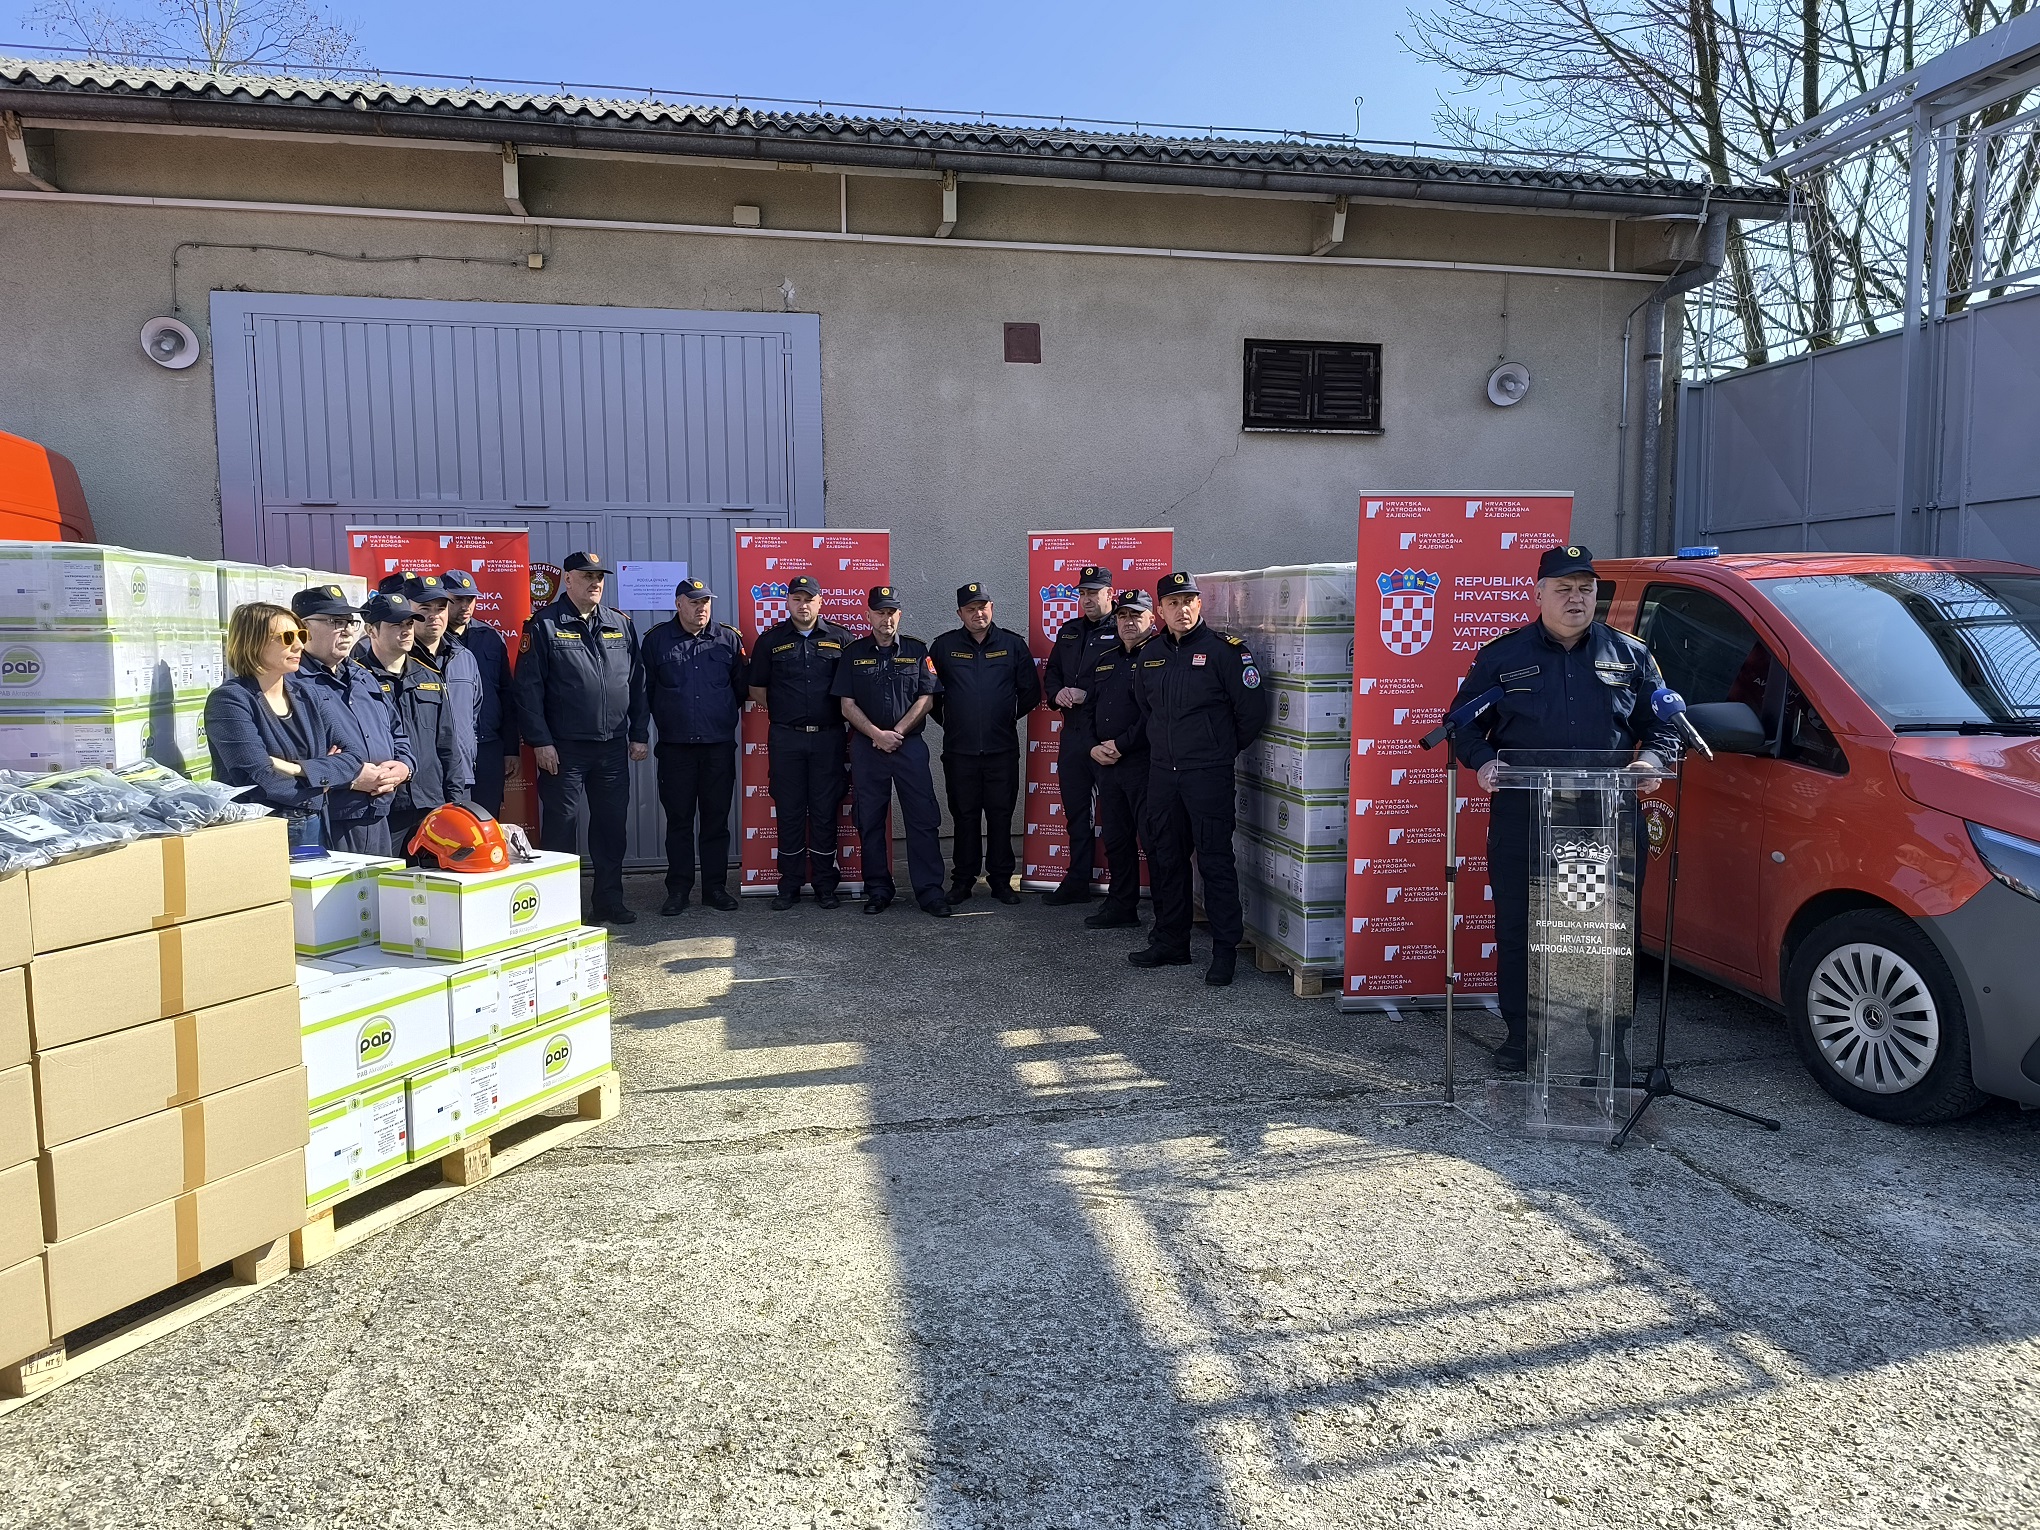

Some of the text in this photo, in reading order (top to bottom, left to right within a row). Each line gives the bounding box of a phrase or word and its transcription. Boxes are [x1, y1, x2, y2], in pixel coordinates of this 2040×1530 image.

[529, 564, 560, 576] ROGASTVO
[1454, 576, 1535, 586] REPUBLIKA
[820, 588, 866, 596] PUBLIKA
[1454, 590, 1530, 601] HRVATSKA
[1453, 612, 1529, 622] HRVATSKA
[1453, 627, 1509, 637] VATRO
[2, 660, 40, 674] pab
[1650, 844, 1661, 854] HVZ
[512, 896, 537, 914] pab
[1536, 920, 1626, 930] REPUBLIKA HRVATSKA
[1559, 934, 1603, 944] HRVATSKA
[1530, 944, 1632, 956] VATROGASNA ZAJEDNICA
[360, 1030, 392, 1054] pab
[546, 1047, 569, 1066] pab
